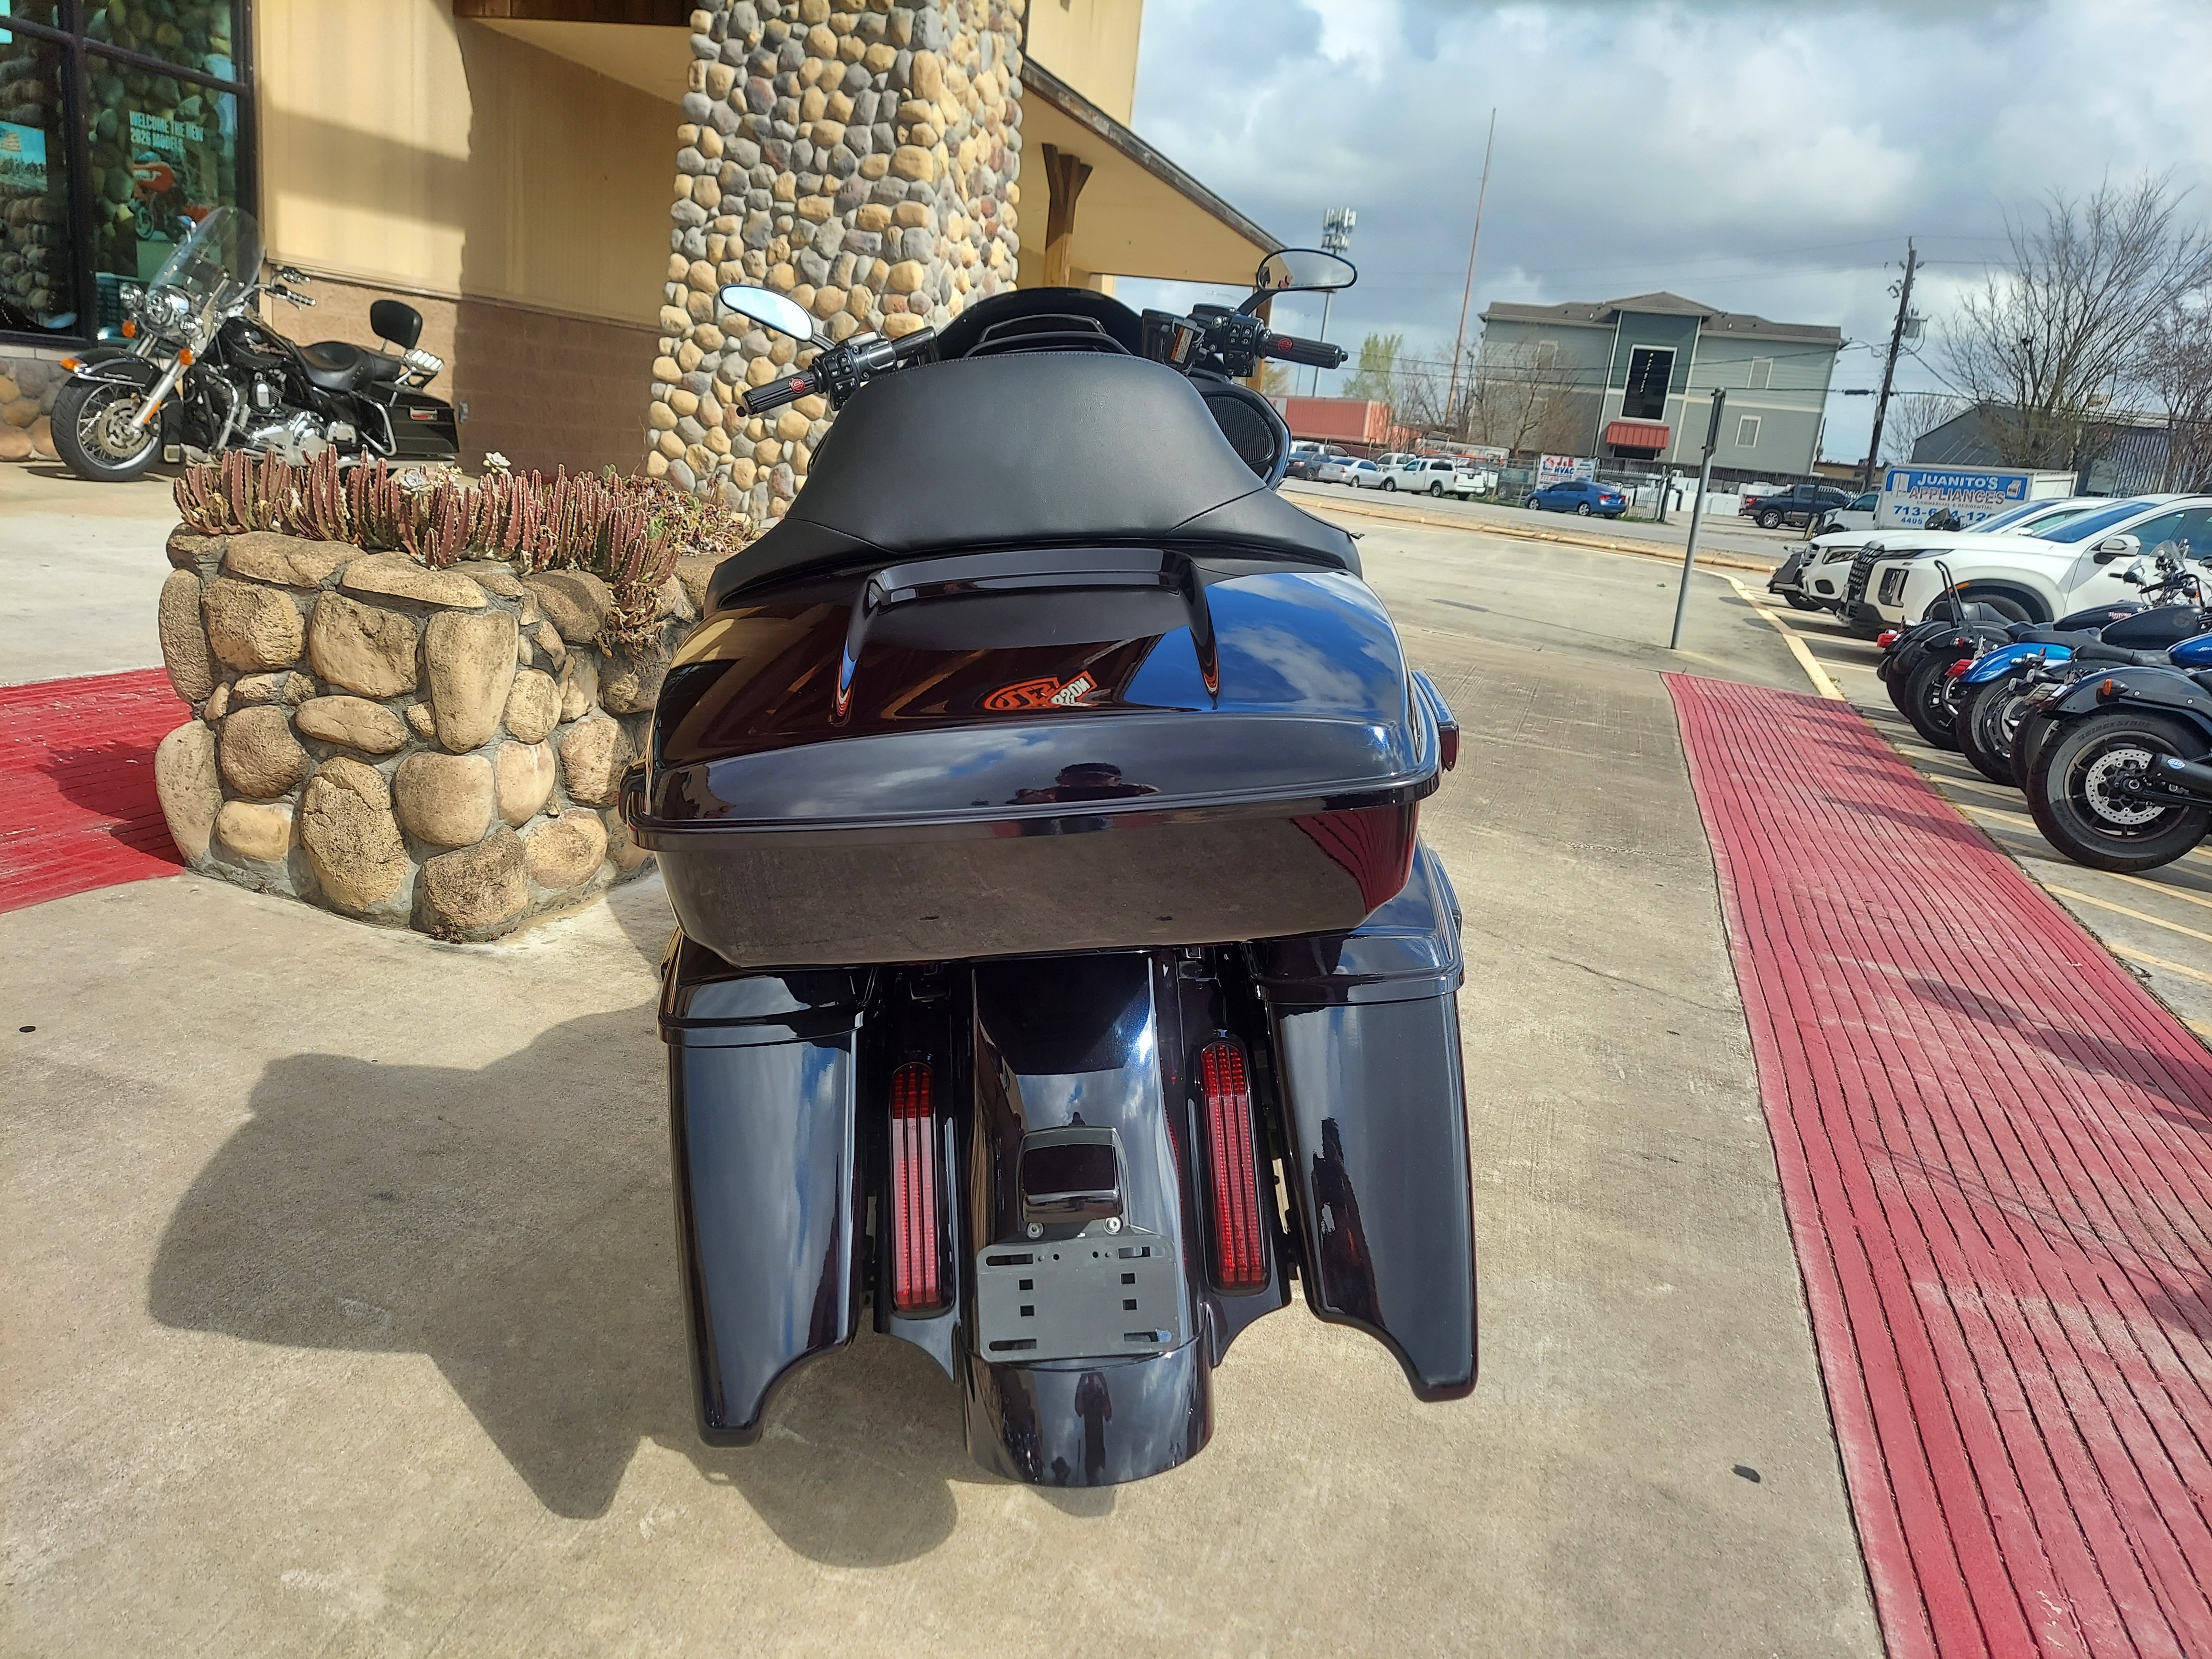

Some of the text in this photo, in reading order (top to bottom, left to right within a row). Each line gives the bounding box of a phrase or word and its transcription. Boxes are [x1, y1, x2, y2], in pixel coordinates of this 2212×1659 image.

[130, 111, 203, 142] WELCOME THE NEW
[1917, 473, 1999, 490] JUANITO'S
[1909, 486, 2005, 505] APPLIANCES
